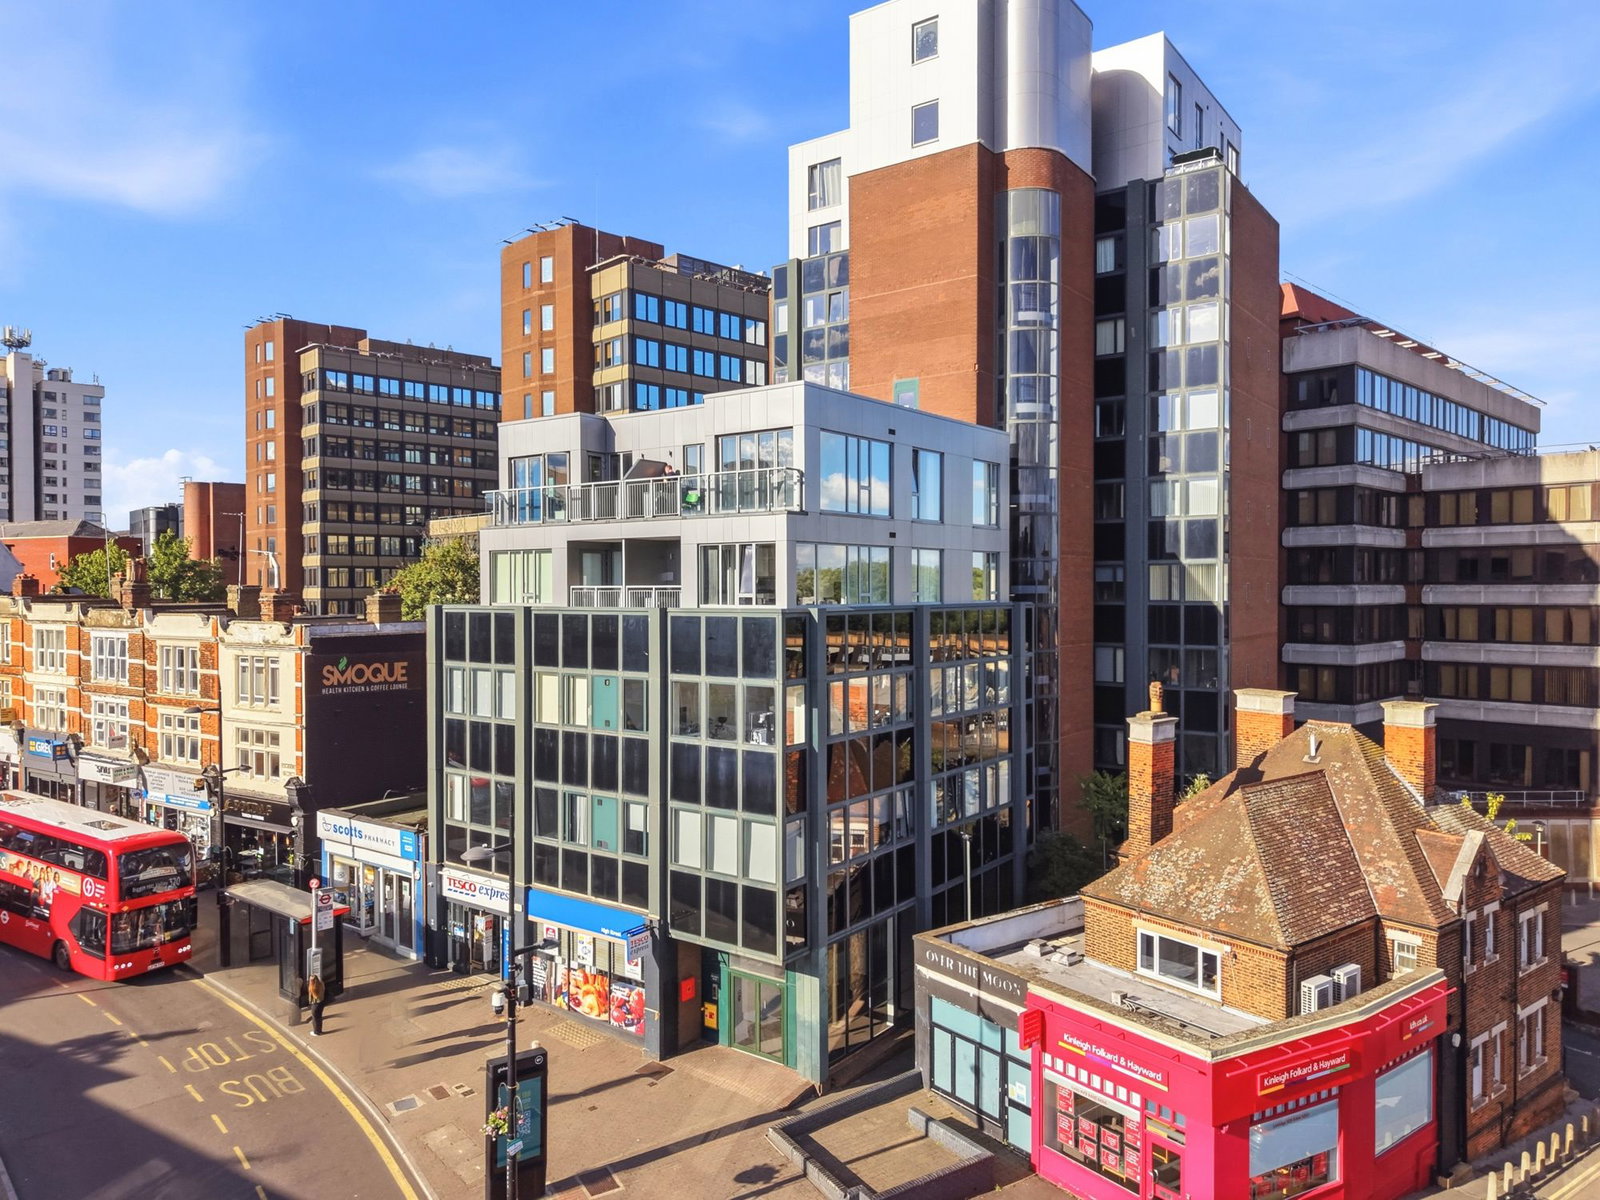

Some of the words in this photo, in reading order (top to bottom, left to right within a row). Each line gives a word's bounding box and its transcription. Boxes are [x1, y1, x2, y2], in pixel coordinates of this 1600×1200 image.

[322, 661, 408, 686] SMOQUE
[322, 687, 341, 695] HEALTH
[343, 685, 365, 693] KITCHEN
[371, 683, 389, 691] COFFEE
[35, 741, 53, 753] GRE
[333, 824, 363, 839] scotts
[364, 834, 395, 846] PHARMACY
[447, 877, 477, 893] TESCO
[478, 885, 510, 902] expres
[630, 934, 649, 947] TESCO
[926, 950, 954, 970] OVER
[957, 961, 978, 979] THE
[983, 971, 1021, 996] MOON
[182, 1031, 277, 1073] STOP
[1063, 1033, 1091, 1052] Kinleigh
[1092, 1045, 1118, 1063] Folkard
[1119, 1057, 1126, 1066] &
[1127, 1059, 1162, 1081] Hayward
[1264, 1072, 1289, 1087] Kinleigh
[1290, 1064, 1312, 1079] Folkard
[1313, 1062, 1319, 1071] &
[1320, 1053, 1346, 1069] Hayward
[219, 1066, 306, 1107] BUS
